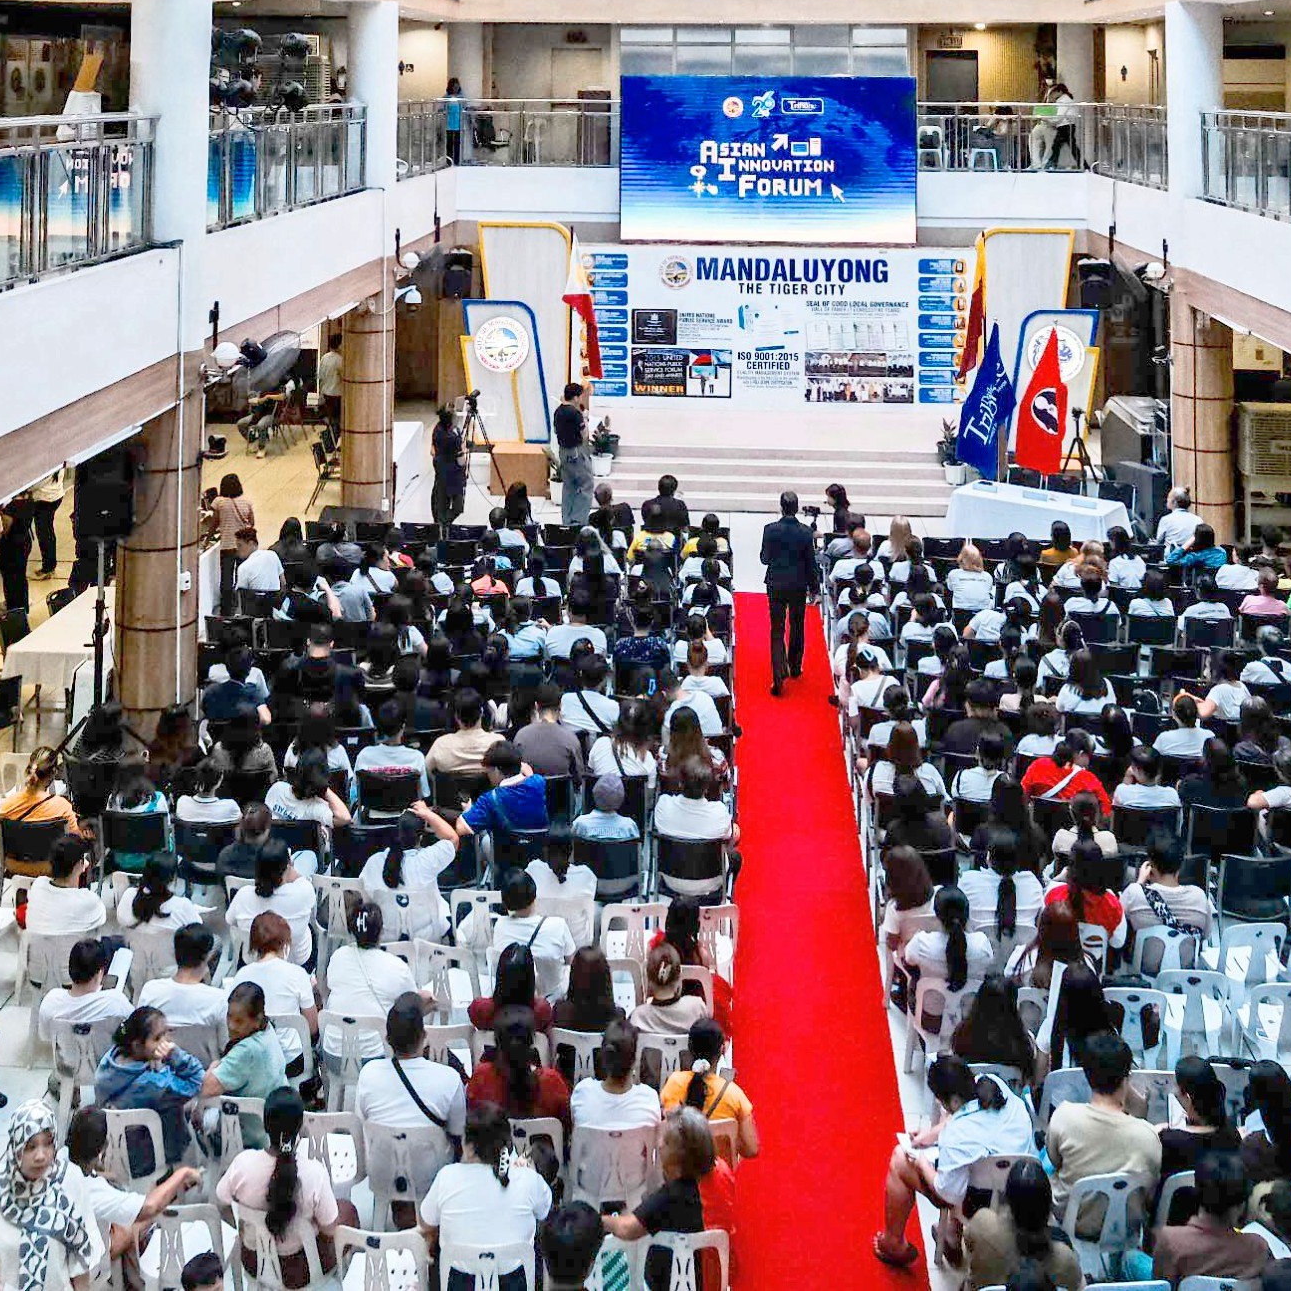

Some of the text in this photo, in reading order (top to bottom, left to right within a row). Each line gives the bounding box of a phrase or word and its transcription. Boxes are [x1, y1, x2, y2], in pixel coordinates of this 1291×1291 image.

[696, 256, 889, 284] MANDALUYONG
[739, 283, 846, 296] THE TIGER CITY
[738, 351, 799, 362] ISO 9001:2015
[746, 361, 790, 371] CERTIFIED
[634, 384, 684, 394] WINNER
